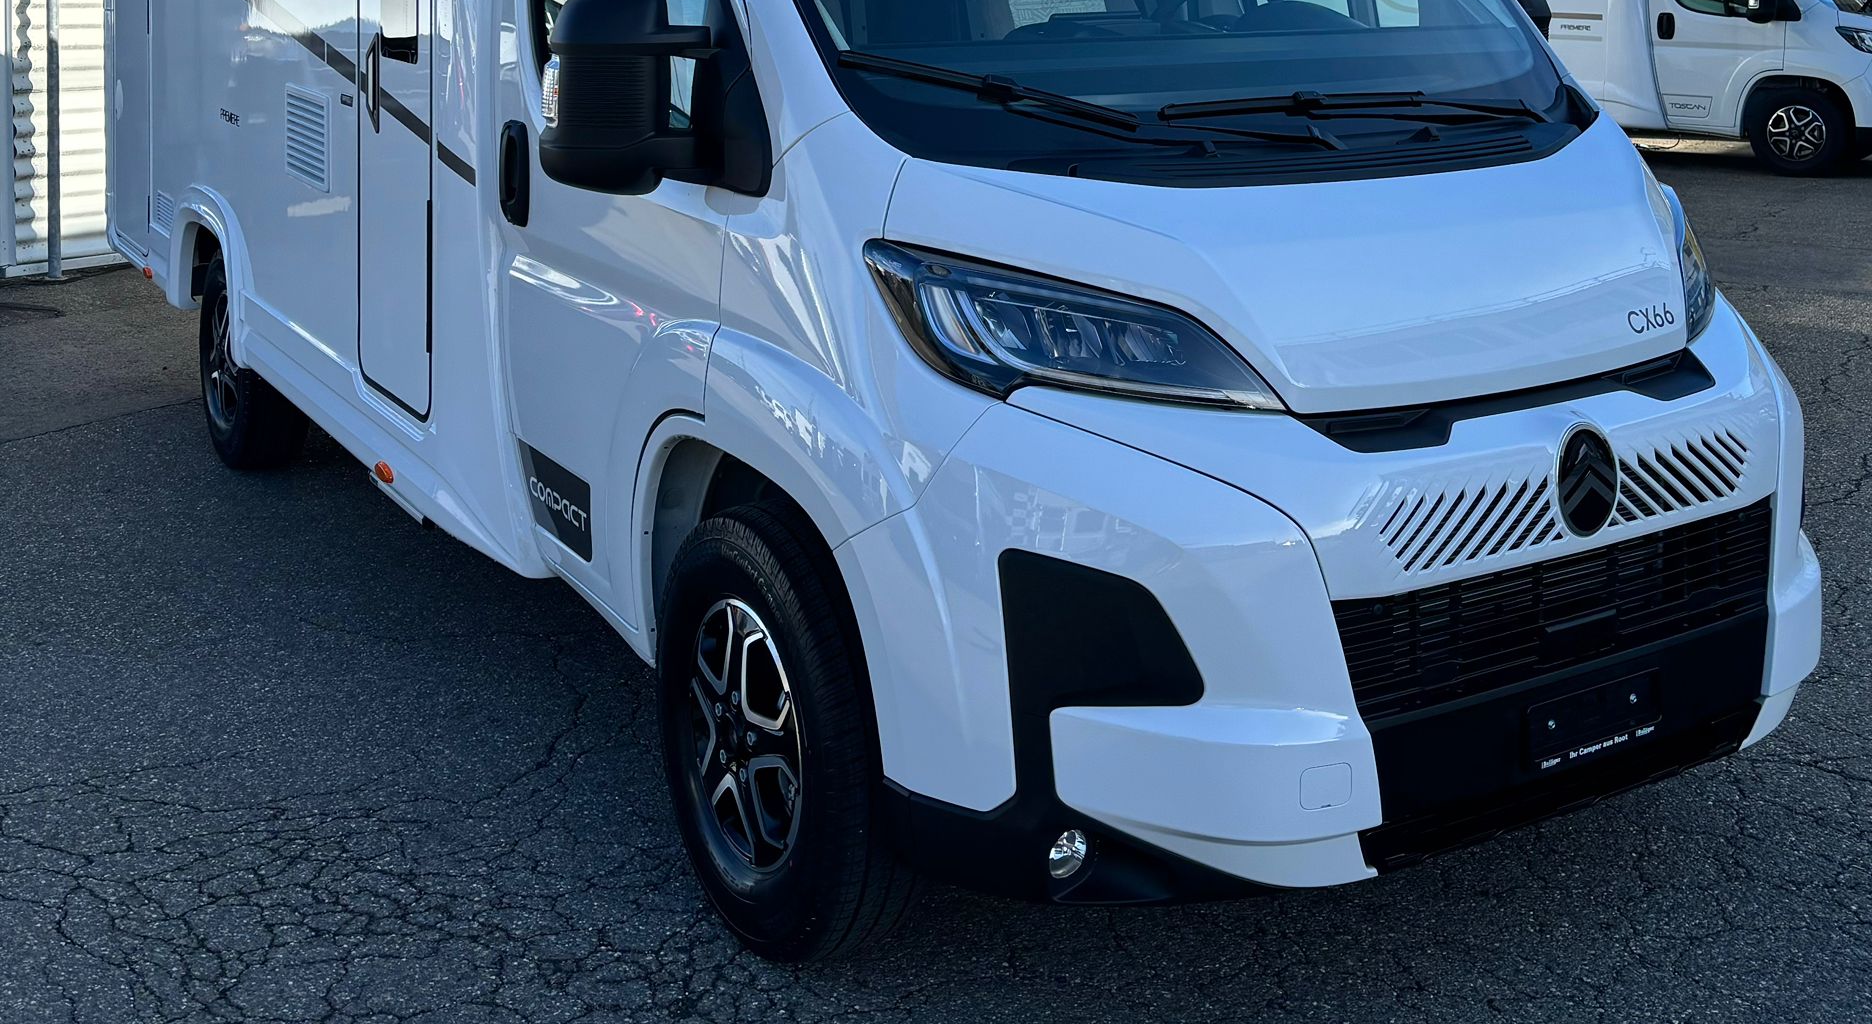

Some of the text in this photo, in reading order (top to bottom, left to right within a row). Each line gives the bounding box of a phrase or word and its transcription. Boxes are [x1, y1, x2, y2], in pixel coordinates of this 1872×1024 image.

[1669, 102, 1706, 111] TOSCAN
[1627, 302, 1675, 334] CX66
[529, 476, 587, 532] COMPACT
[1579, 742, 1602, 756] Camper
[1603, 739, 1614, 748] aus
[1614, 734, 1629, 745] Root
